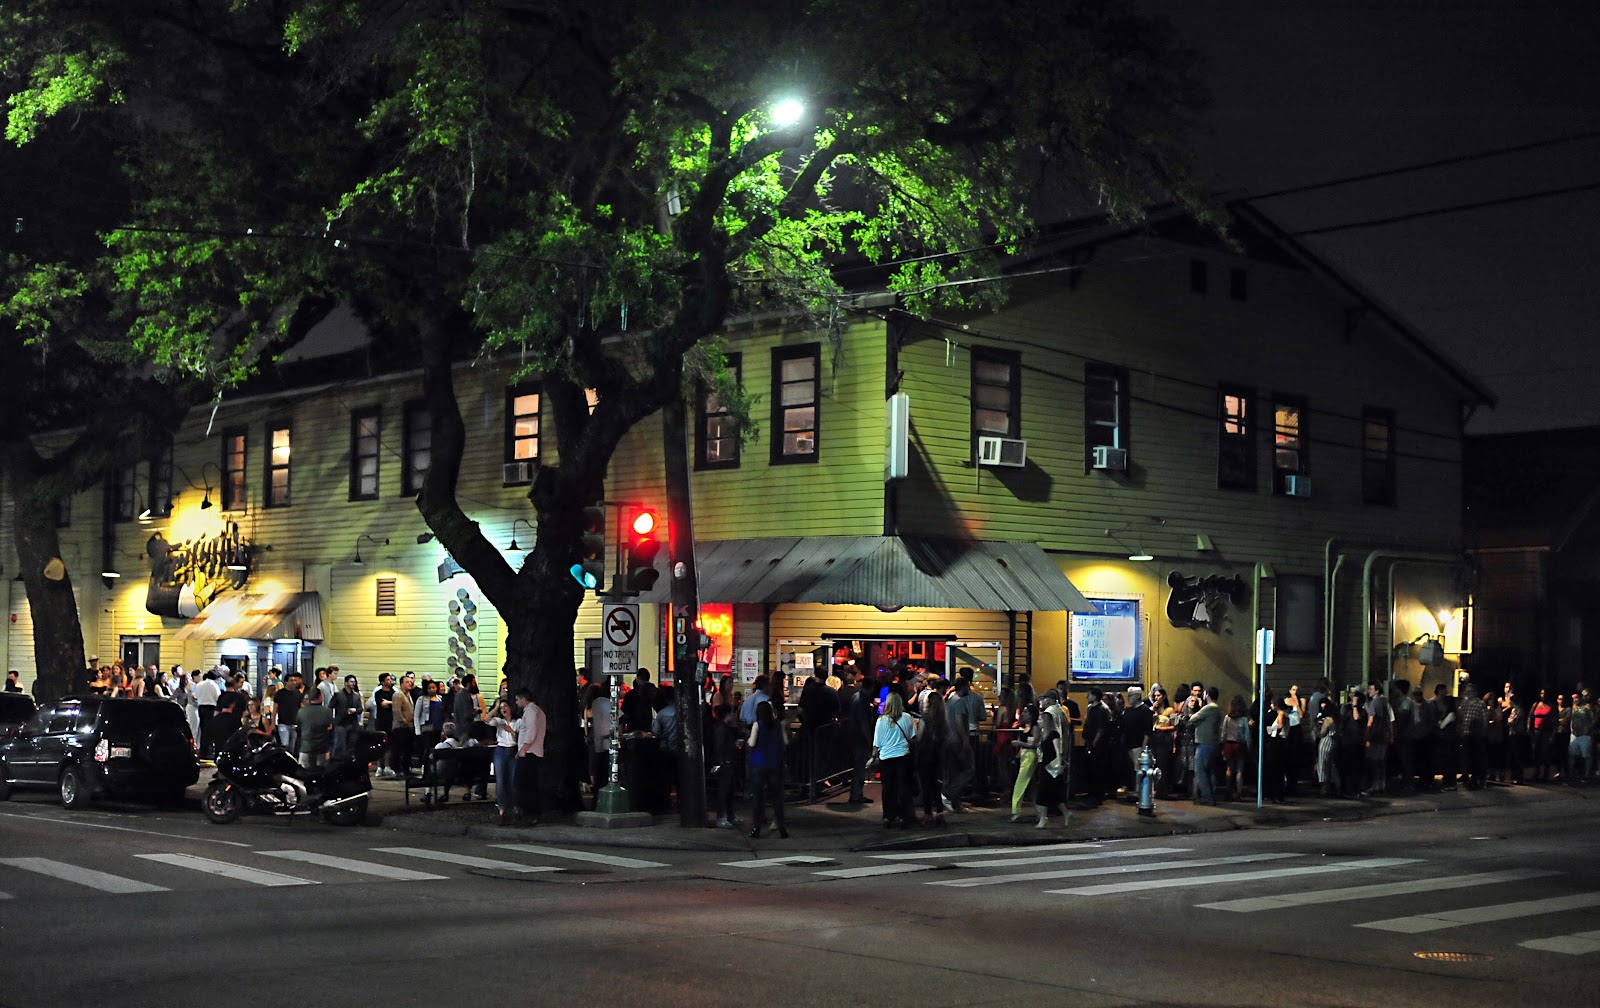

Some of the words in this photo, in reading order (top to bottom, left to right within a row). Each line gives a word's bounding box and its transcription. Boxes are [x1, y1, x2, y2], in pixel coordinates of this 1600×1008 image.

[604, 650, 613, 659] NO
[796, 655, 812, 665] EXIT
[609, 662, 630, 671] ROUTE
[1080, 660, 1094, 669] FROM
[1099, 660, 1112, 670] CUBA
